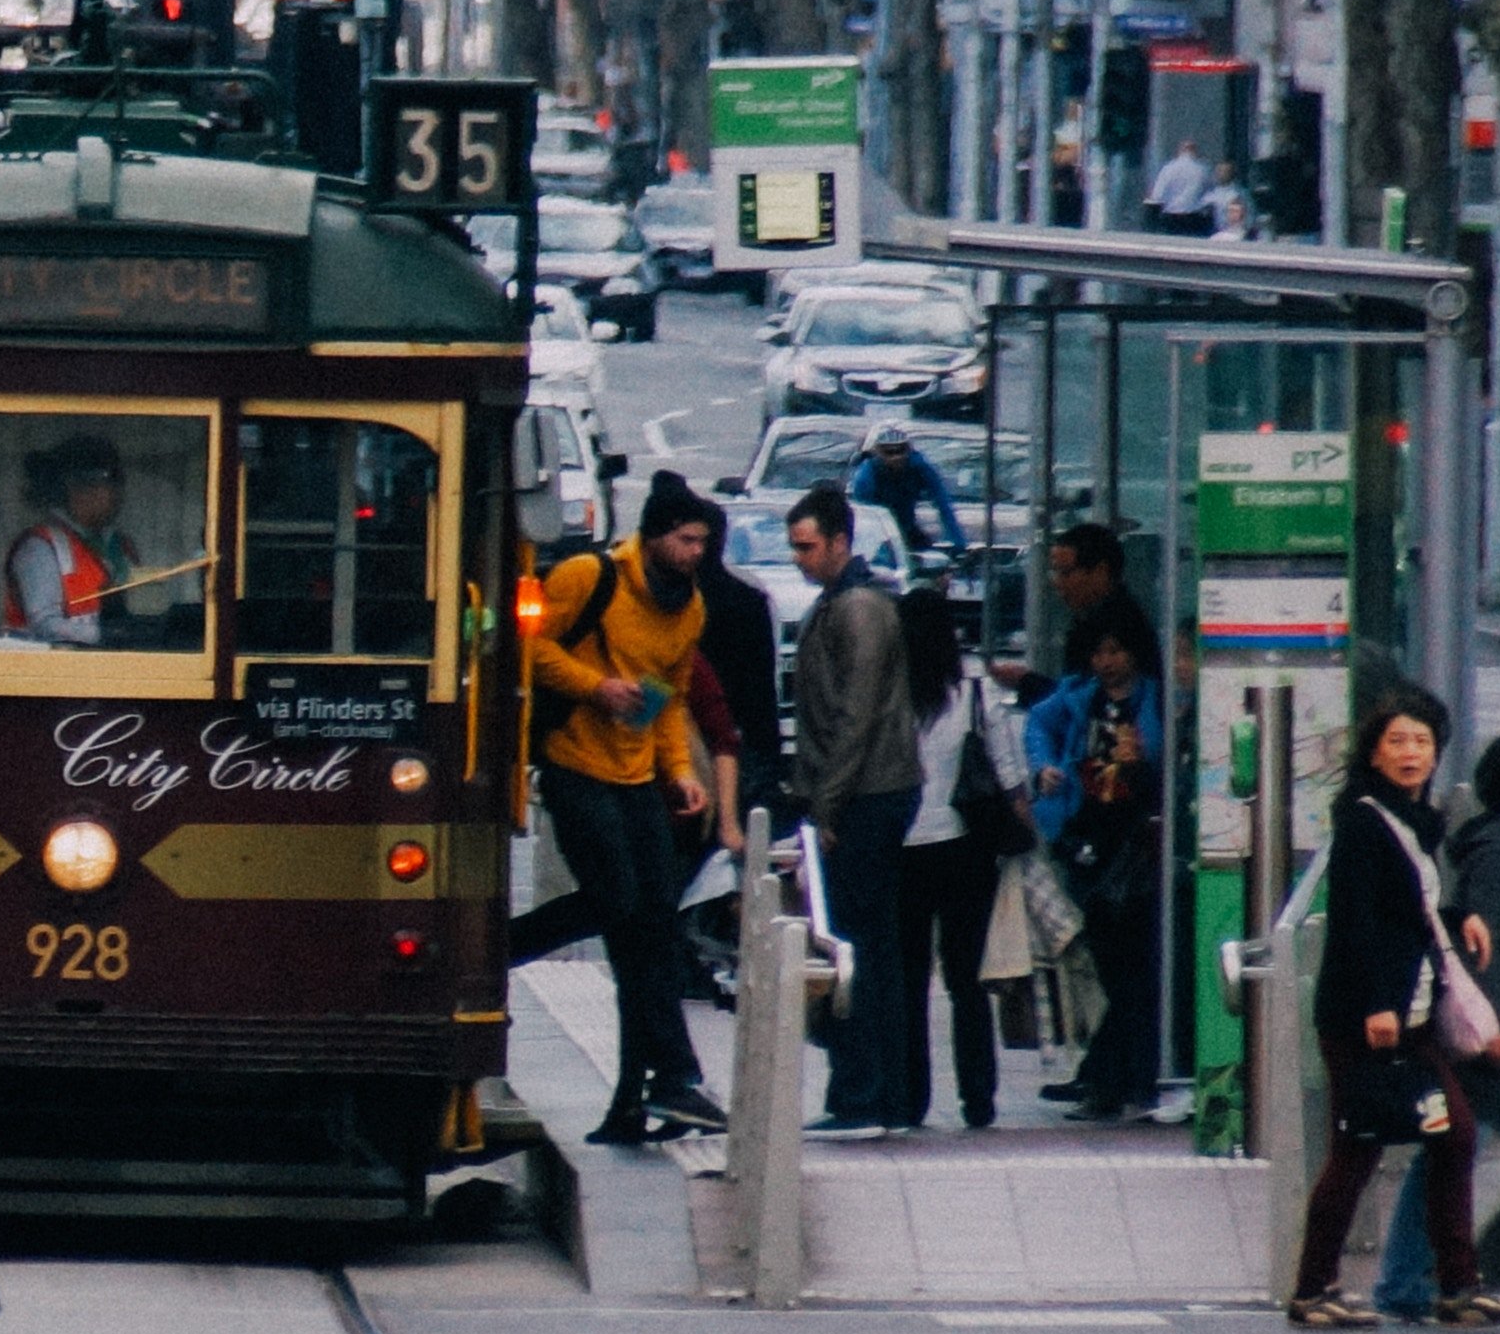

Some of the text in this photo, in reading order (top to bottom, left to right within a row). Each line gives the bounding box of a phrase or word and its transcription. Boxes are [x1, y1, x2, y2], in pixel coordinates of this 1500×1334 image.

[398, 109, 498, 194] 35
[1317, 591, 1342, 612] 4
[256, 697, 417, 720] via Flinders St
[53, 712, 360, 811] City Circle
[25, 922, 130, 981] 928
